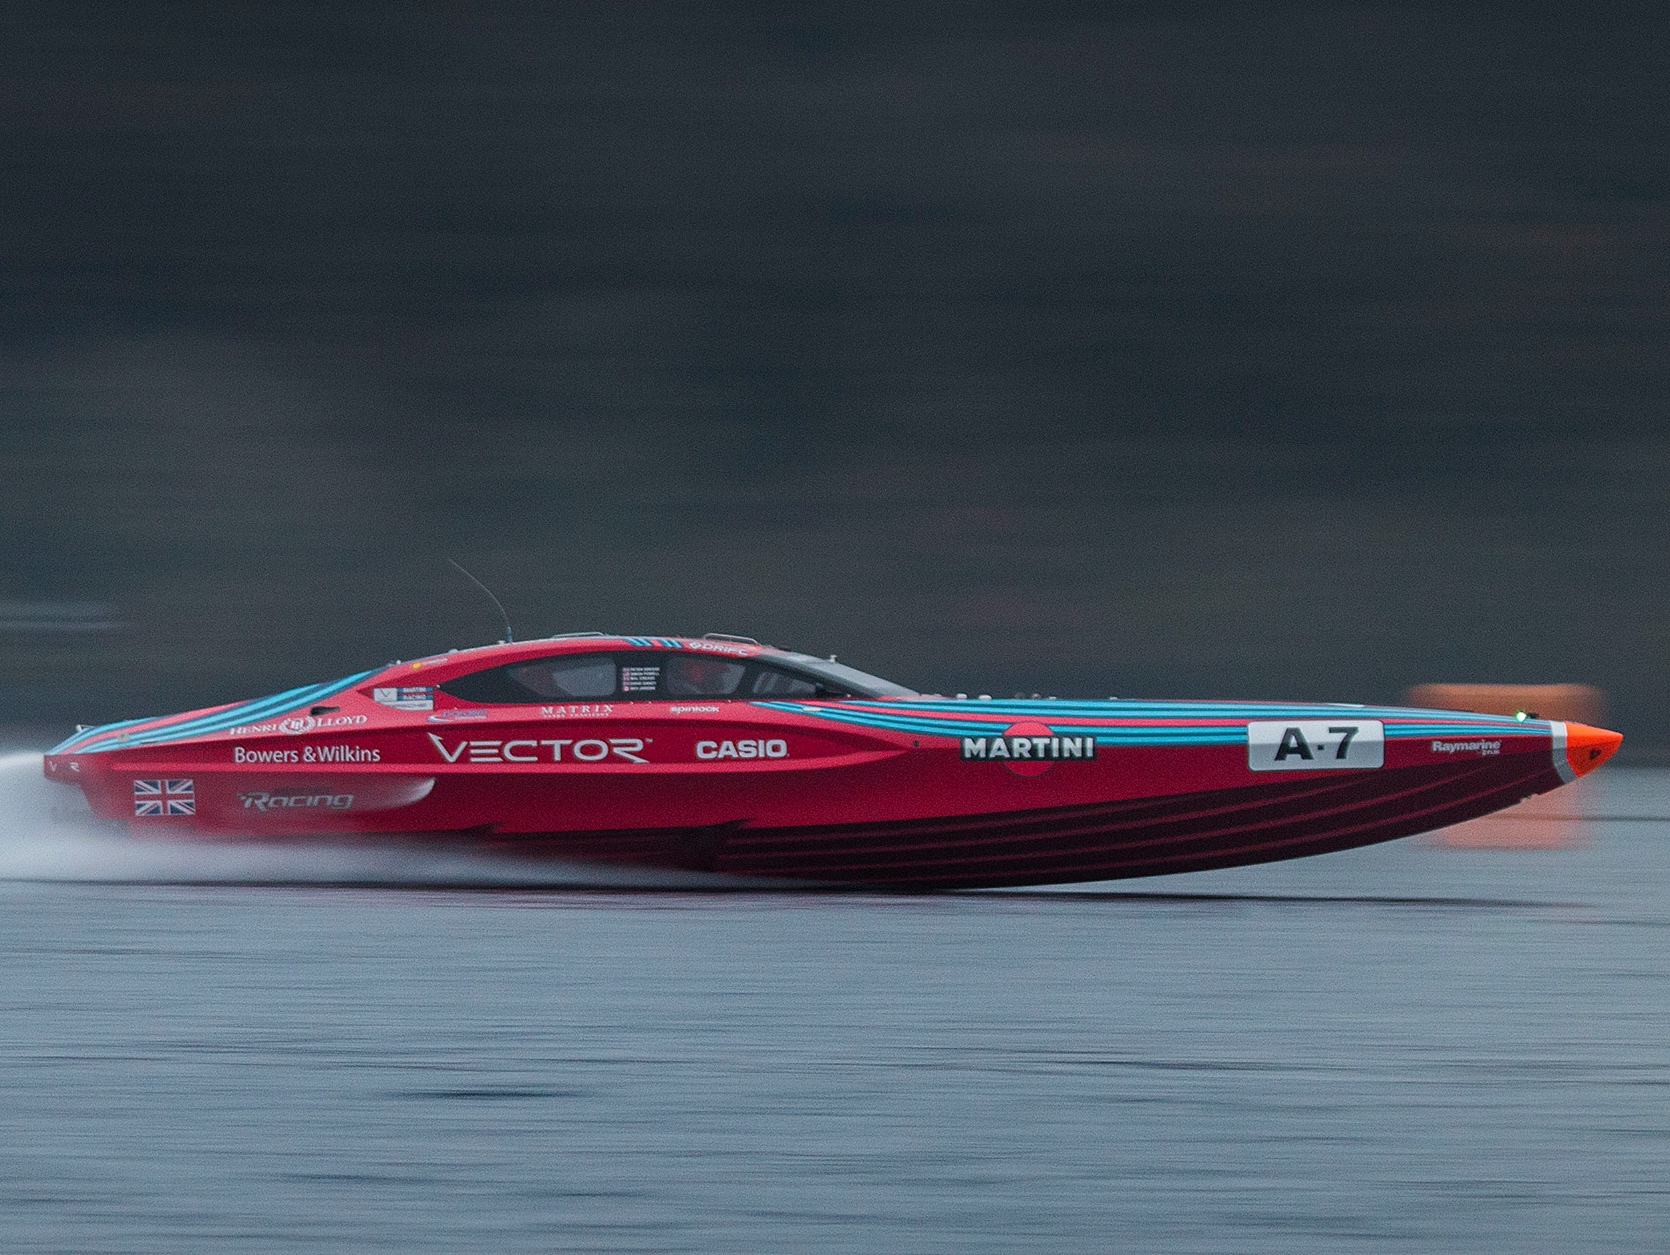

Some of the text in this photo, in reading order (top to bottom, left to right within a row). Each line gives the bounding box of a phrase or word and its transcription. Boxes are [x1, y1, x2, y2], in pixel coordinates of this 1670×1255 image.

[540, 704, 613, 714] MATRIX
[670, 705, 719, 714] spinlock
[230, 714, 368, 735] HENRI LLOYD
[234, 746, 299, 763] Bowers
[696, 739, 788, 759] CASIO
[964, 736, 1094, 759] MARTINI
[1432, 739, 1501, 754] Raymarine
[236, 790, 354, 813] Racing
